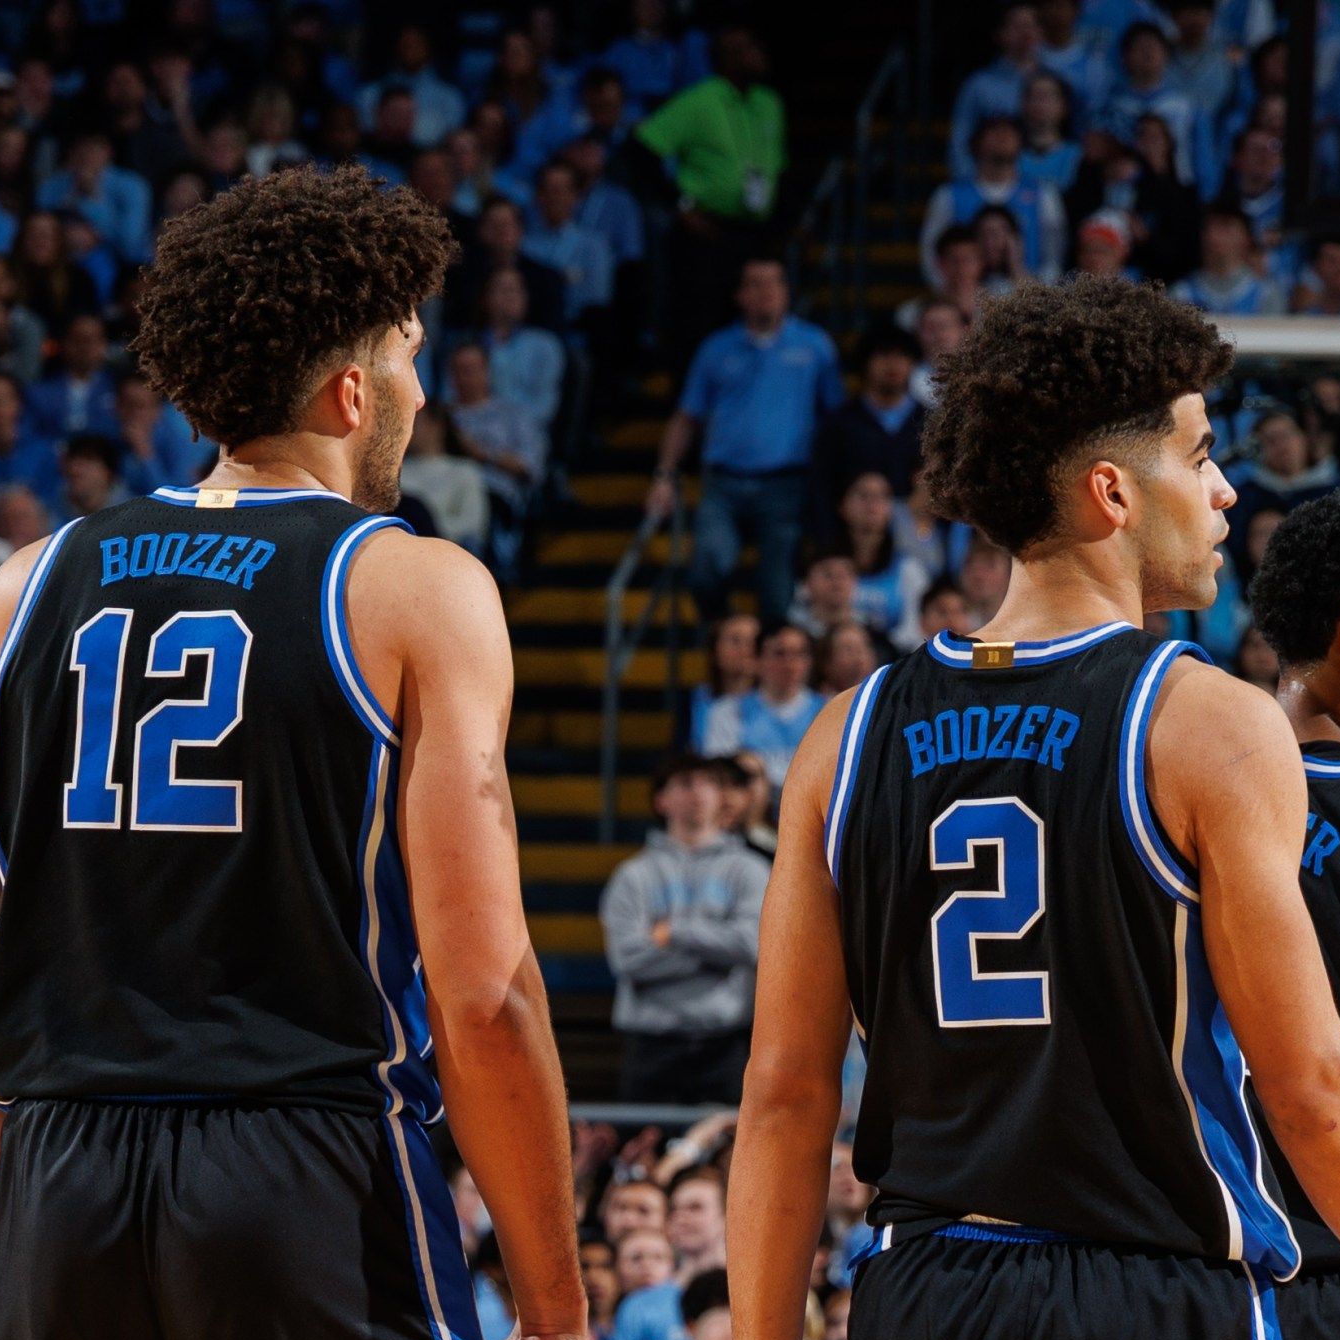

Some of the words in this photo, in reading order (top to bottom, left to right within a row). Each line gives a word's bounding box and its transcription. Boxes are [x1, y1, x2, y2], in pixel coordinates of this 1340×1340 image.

[99, 532, 277, 591] BOOZER
[62, 607, 254, 833] 12
[903, 704, 1080, 778] BOOZER
[929, 795, 1052, 1028] 2
